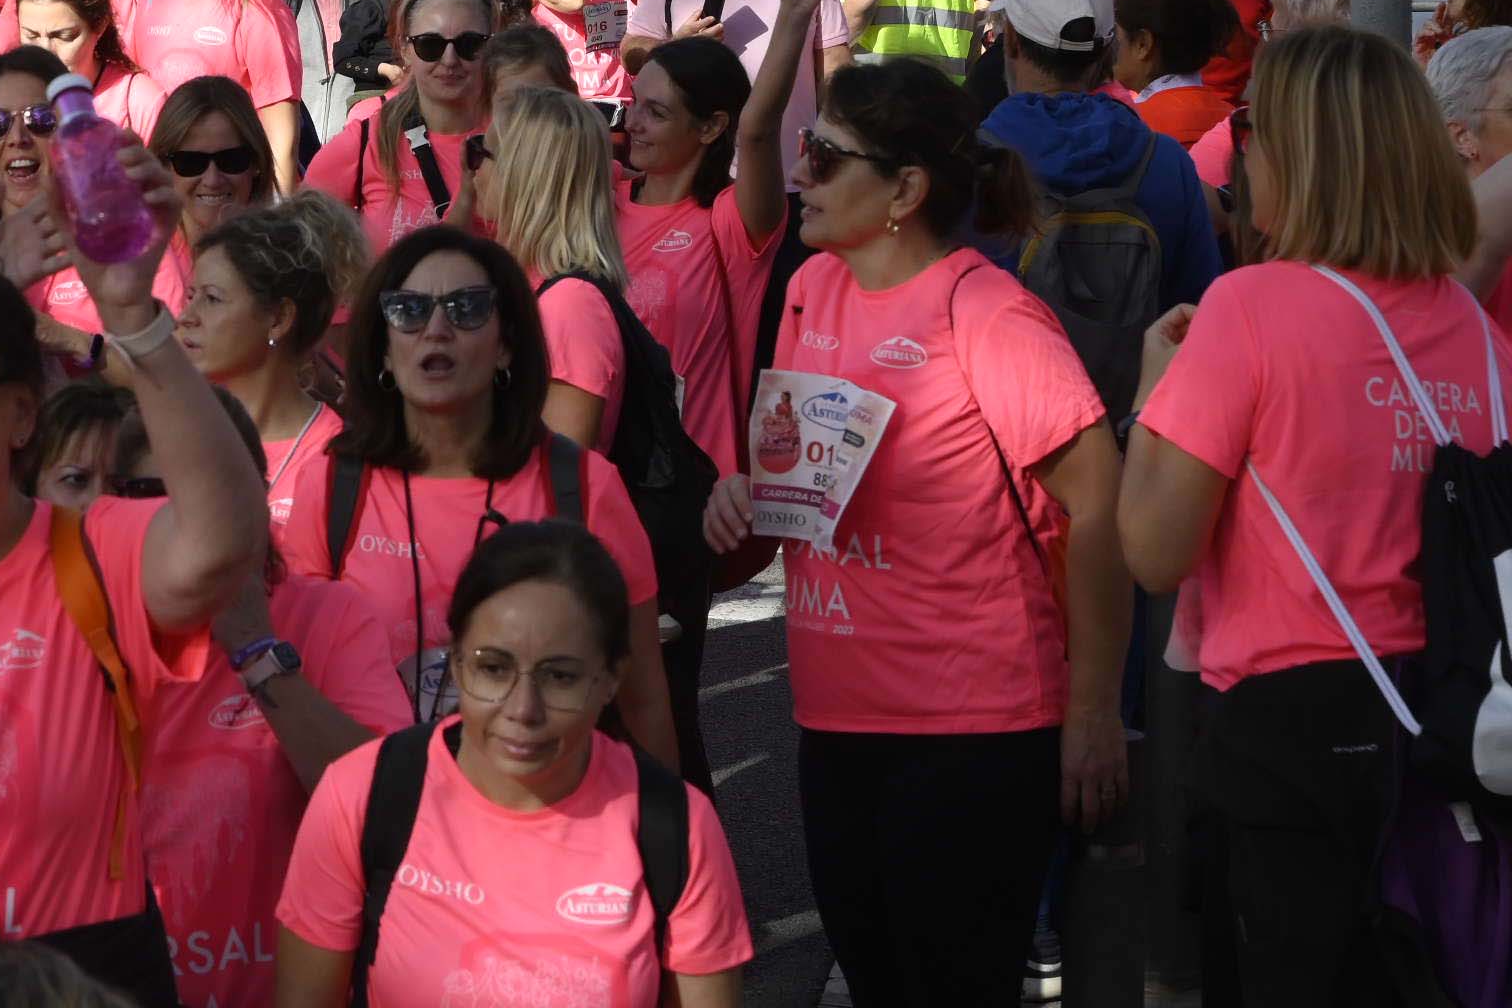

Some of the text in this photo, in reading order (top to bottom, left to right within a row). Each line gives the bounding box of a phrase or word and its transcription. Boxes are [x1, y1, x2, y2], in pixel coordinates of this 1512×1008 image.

[588, 21, 607, 33] 016
[1394, 410, 1428, 441] DE
[761, 489, 809, 501] CARRERA
[786, 576, 851, 620] UMA
[398, 864, 485, 905] OYSHO
[567, 899, 630, 914] ASTURIAN
